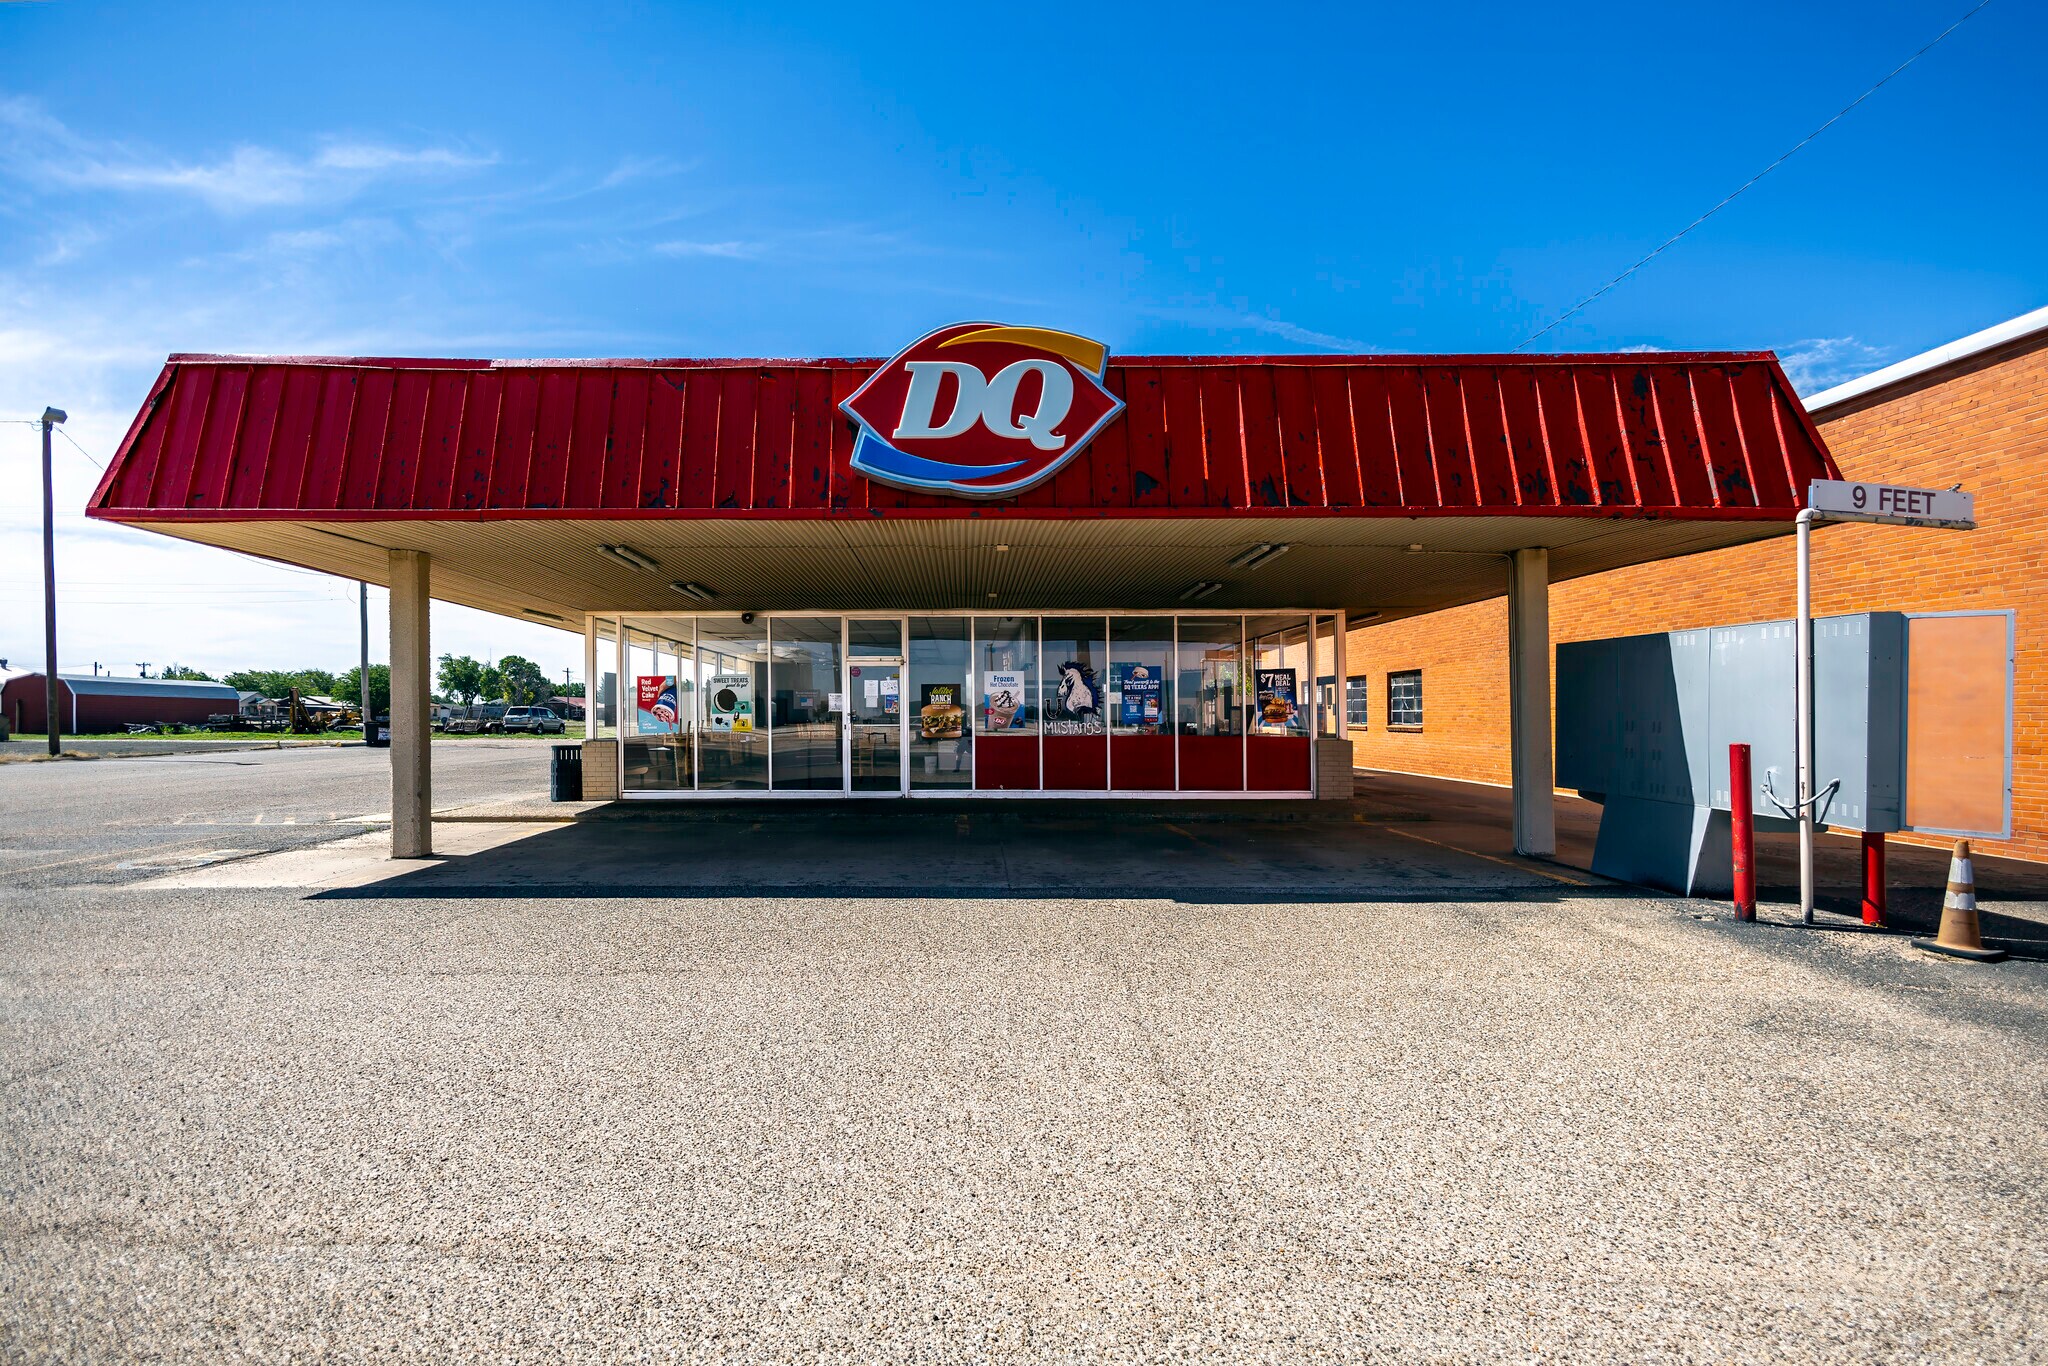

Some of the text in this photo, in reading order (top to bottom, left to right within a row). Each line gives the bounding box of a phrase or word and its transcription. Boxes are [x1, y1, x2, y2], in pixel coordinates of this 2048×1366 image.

[892, 358, 1074, 450] DQ
[1852, 485, 1936, 515] 9 FEET
[1260, 673, 1274, 688] $7
[931, 694, 952, 704] RANCH
